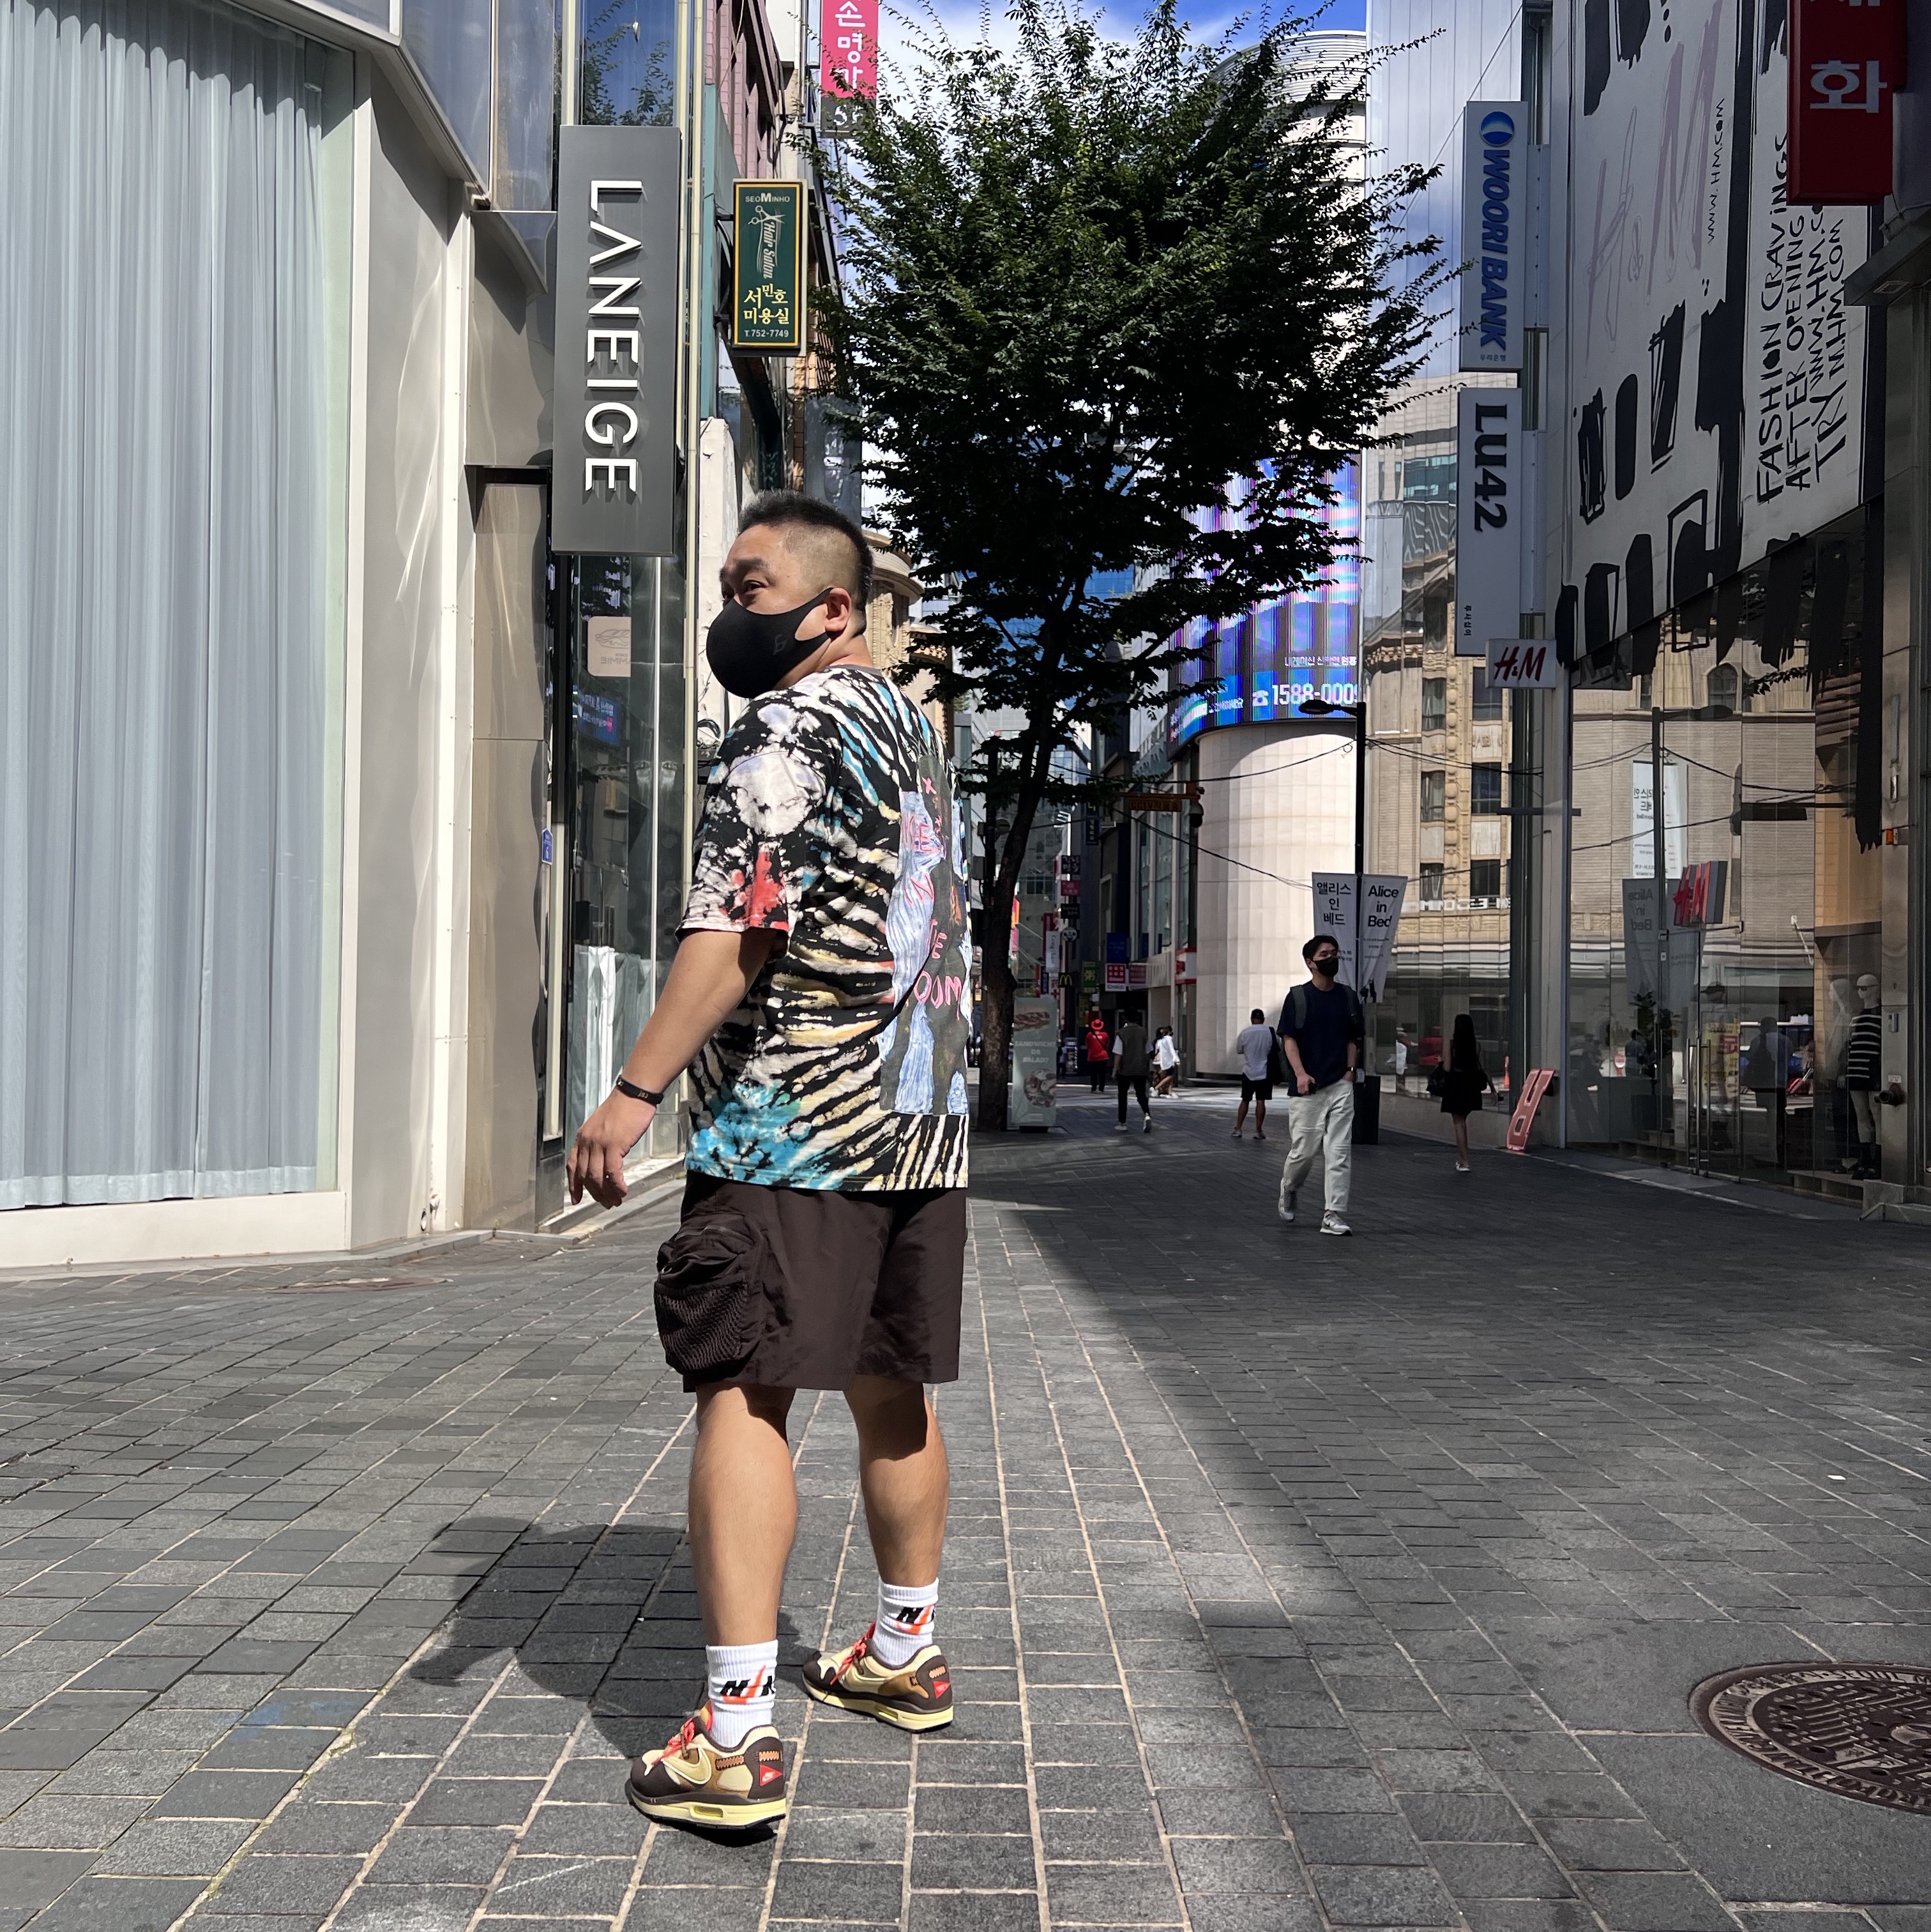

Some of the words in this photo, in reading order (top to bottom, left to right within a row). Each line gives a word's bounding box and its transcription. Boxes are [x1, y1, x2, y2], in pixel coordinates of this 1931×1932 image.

[745, 192, 791, 202] SEOMINHO
[1481, 149, 1510, 254] WOORI
[763, 222, 776, 248] Hair
[762, 248, 776, 279] Salon
[743, 283, 789, 309] 서민호
[1785, 215, 1805, 351] OPENING
[743, 307, 789, 324] 미용실
[1480, 256, 1508, 351] BANK
[584, 179, 642, 493] LANEIGE
[744, 329, 789, 338] T.752-7749
[1480, 354, 1506, 362] 우리은행
[1757, 322, 1784, 503] FASHION
[1785, 360, 1812, 491] AFTER
[1809, 379, 1847, 483] TRY
[1474, 402, 1507, 532] LU42
[1494, 646, 1547, 682] H&M
[1271, 682, 1358, 706] 1588-000
[1317, 881, 1351, 895] 앨리스
[1368, 885, 1399, 898] Alice
[1328, 897, 1340, 911] 인
[1376, 901, 1388, 913] in
[1323, 912, 1346, 925] 베드
[1368, 915, 1392, 927] Bed
